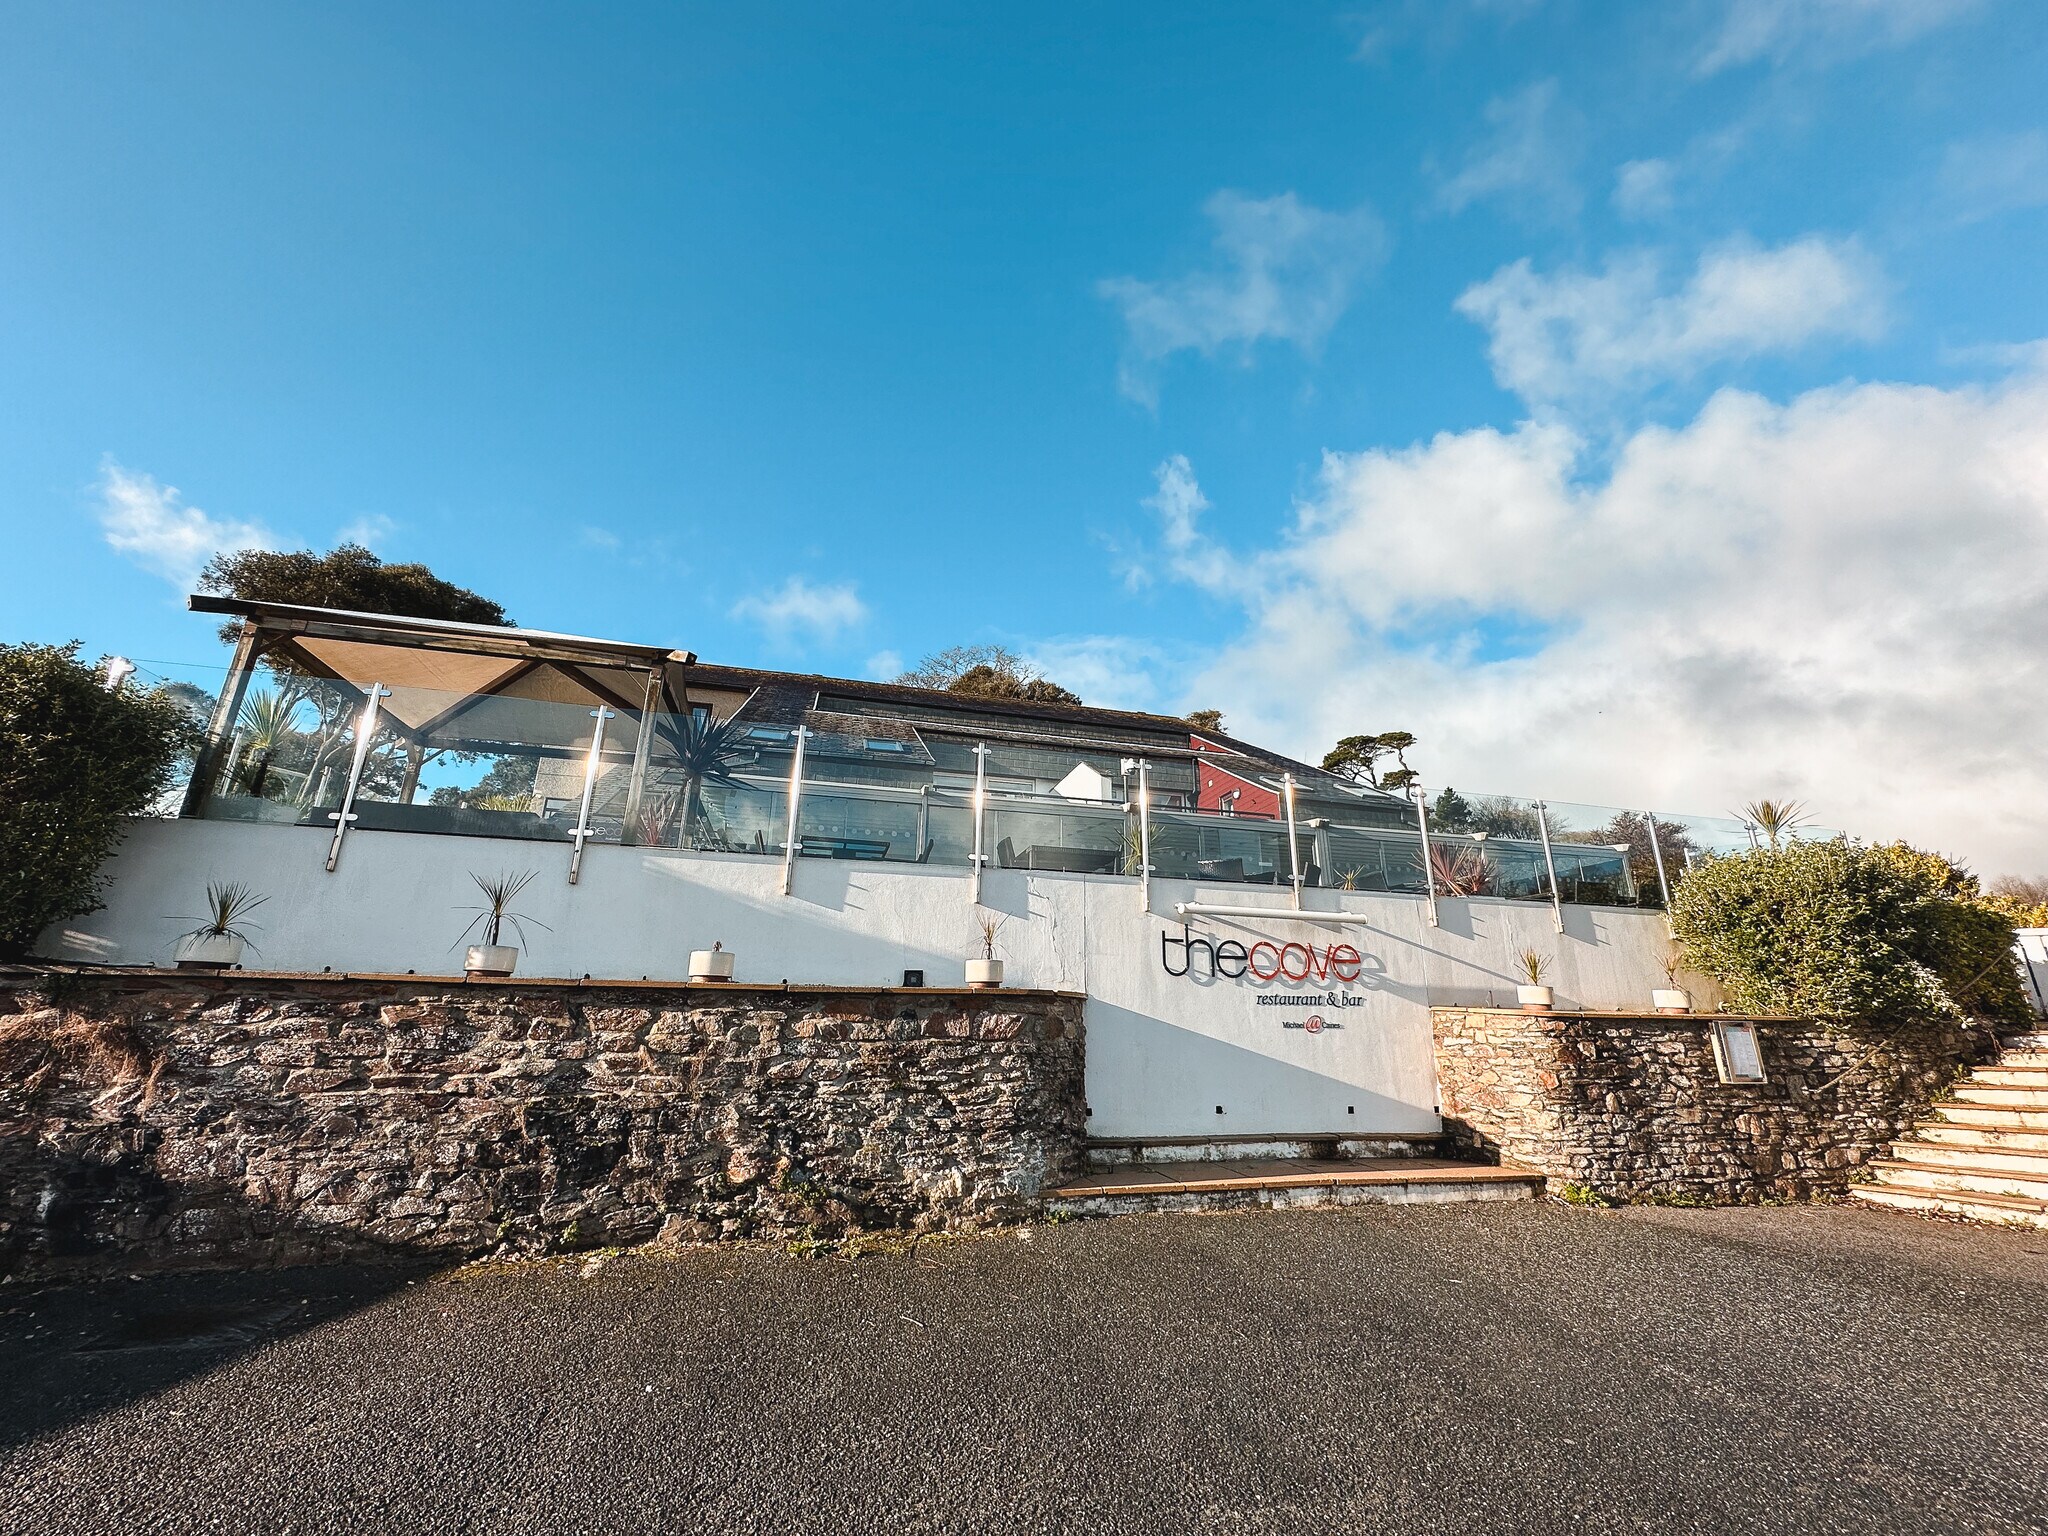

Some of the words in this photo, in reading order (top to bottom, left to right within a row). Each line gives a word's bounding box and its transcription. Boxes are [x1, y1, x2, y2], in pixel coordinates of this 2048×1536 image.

[1256, 993, 1323, 1007] restaurant
[1326, 991, 1346, 1010] &
[1341, 990, 1363, 1007] bar
